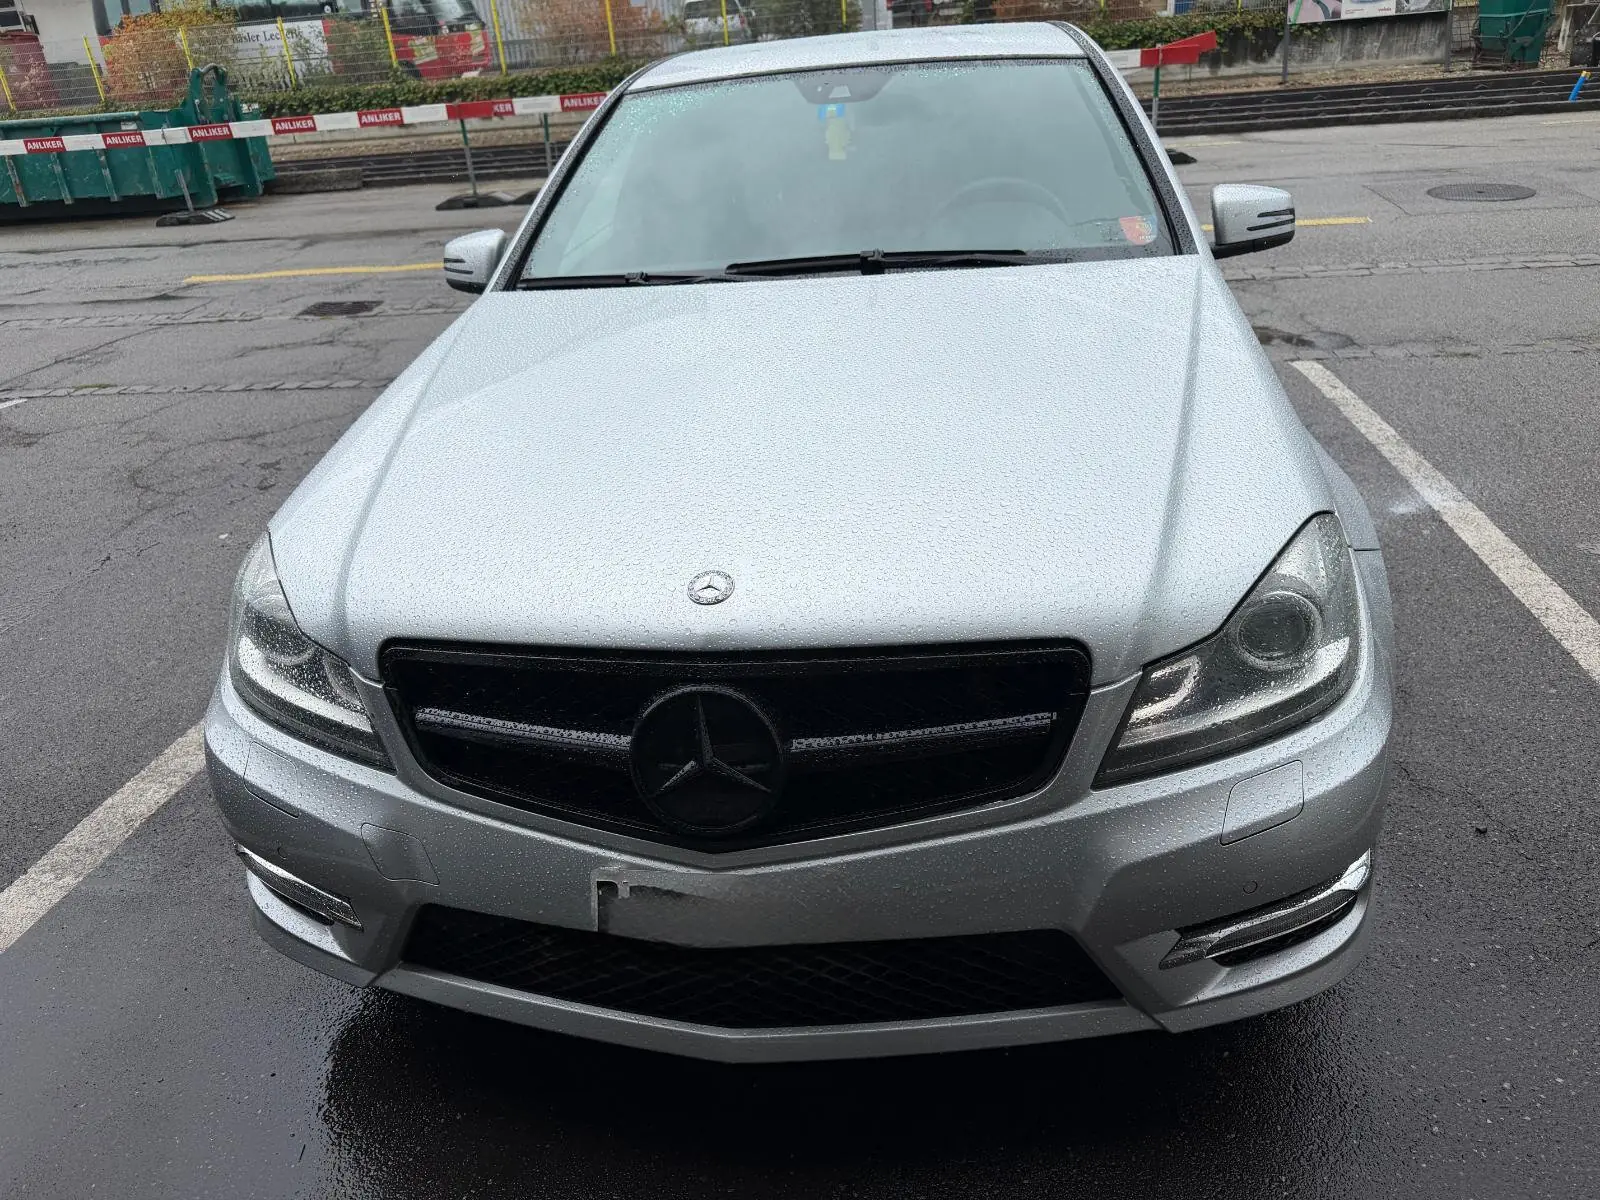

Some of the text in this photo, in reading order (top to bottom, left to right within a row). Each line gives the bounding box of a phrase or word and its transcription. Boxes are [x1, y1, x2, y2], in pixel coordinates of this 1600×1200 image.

[361, 112, 401, 123] ANLIKER
[275, 120, 314, 130] ANLIKER
[192, 127, 230, 137] ANLIKER
[106, 135, 143, 144] ANLIKER
[27, 140, 63, 150] ANLIKER
